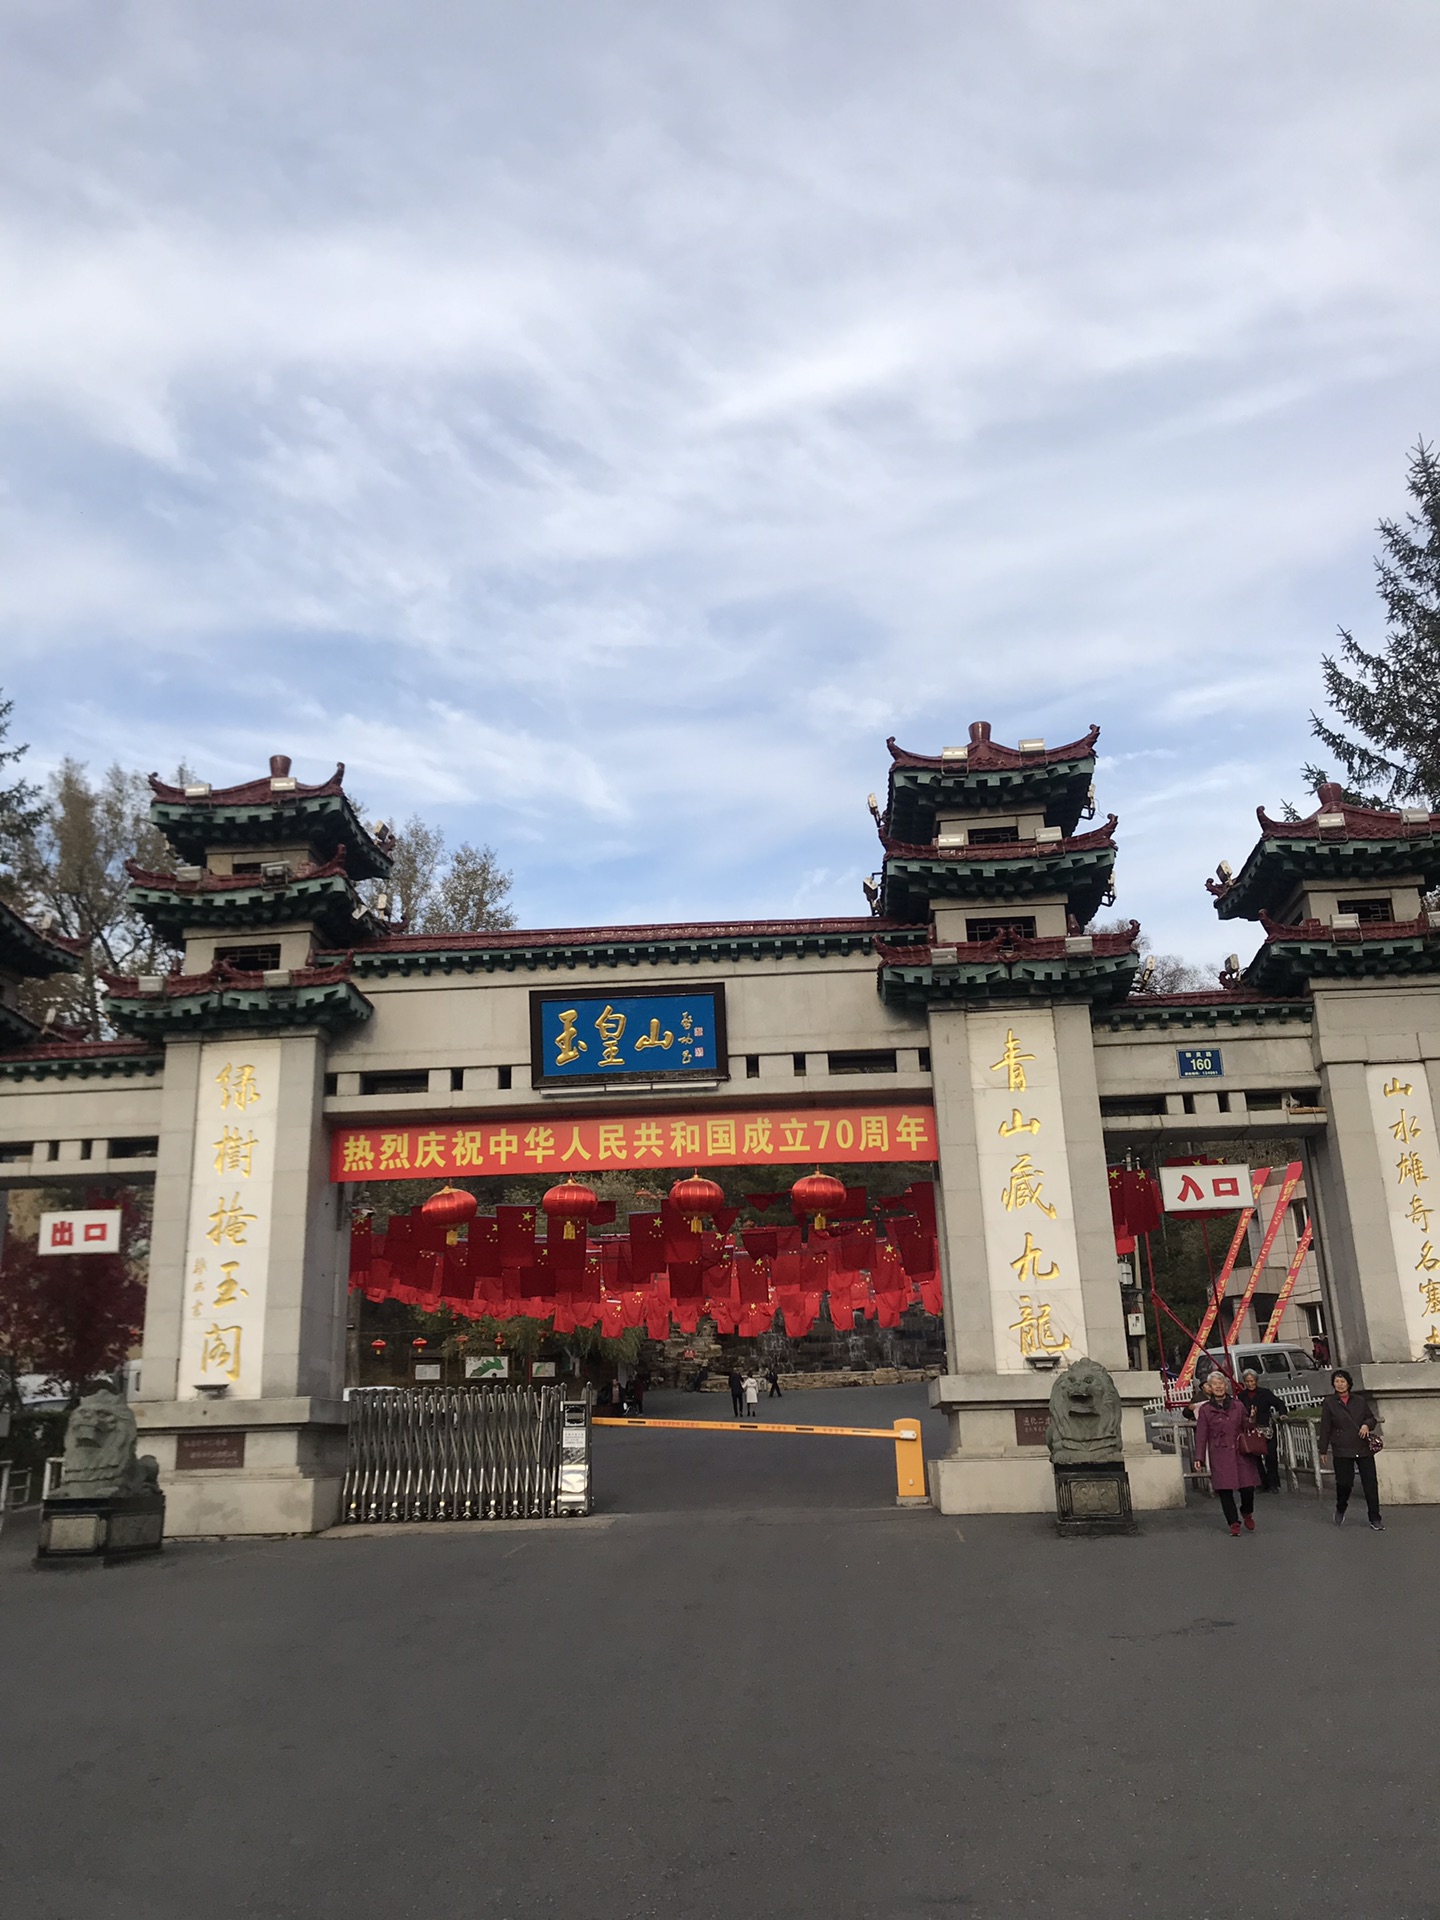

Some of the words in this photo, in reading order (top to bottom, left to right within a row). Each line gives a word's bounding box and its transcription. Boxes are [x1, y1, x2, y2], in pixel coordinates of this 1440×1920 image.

[555, 1004, 675, 1067] 玉皇山
[1190, 1058, 1212, 1070] 160
[342, 1113, 929, 1173] 热烈庆祝中华人民共和国成立70周年
[1177, 1174, 1240, 1203] 入口
[51, 1221, 108, 1247] 出口
